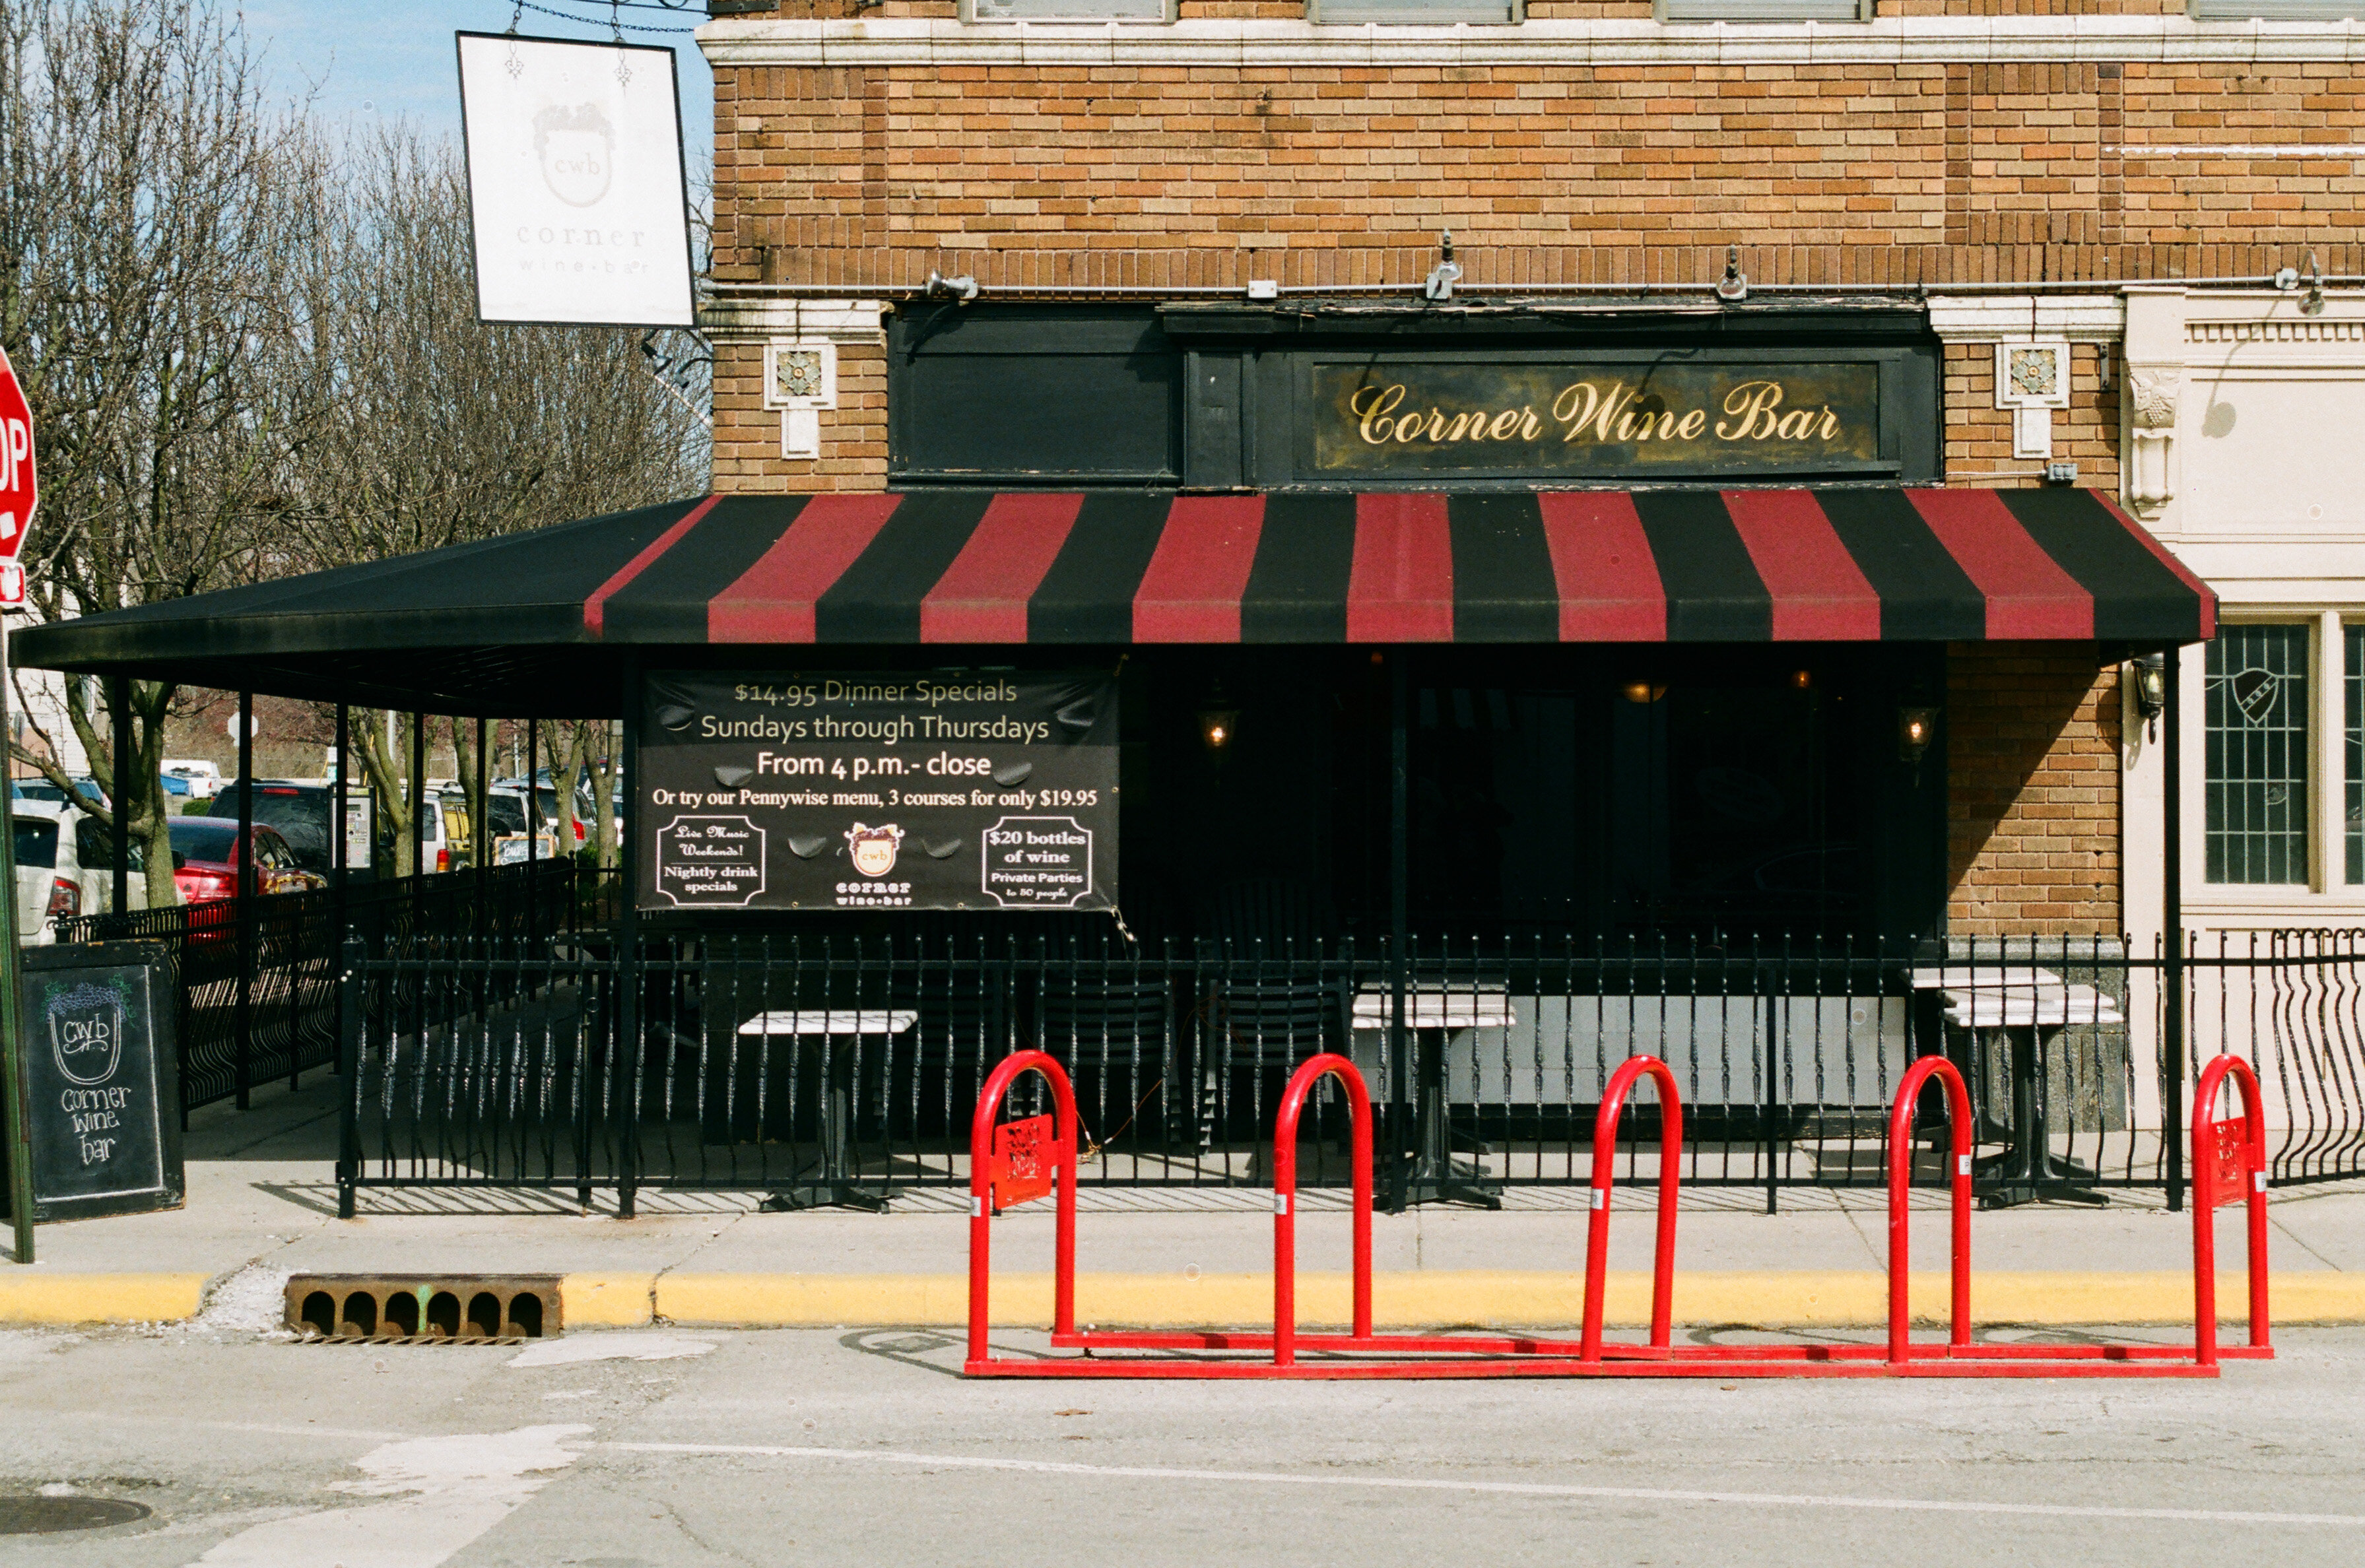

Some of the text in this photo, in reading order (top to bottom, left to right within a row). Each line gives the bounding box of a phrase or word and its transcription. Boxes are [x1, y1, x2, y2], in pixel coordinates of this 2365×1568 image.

[554, 152, 601, 176] cwb
[516, 226, 645, 247] corner
[1350, 382, 1838, 444] Corner Wine Bar
[735, 679, 1018, 708] $14.95 Dinner Specials
[701, 714, 1049, 746] Sundays through Thursdays
[758, 751, 824, 775] From
[830, 758, 848, 781] 4
[926, 750, 991, 775] close
[652, 789, 1098, 810] Or try our Pennywise menu, 3 courses for only $19.95
[675, 826, 749, 839] Live Music
[989, 831, 1086, 845] $20 bottles
[679, 843, 743, 856] Weekends!
[862, 849, 887, 860] cwb
[1004, 849, 1071, 863] of wine
[663, 866, 758, 880] Nightly drink
[990, 872, 1083, 883] Private Parties
[684, 880, 738, 894] specials
[835, 882, 912, 894] corner
[1005, 888, 1017, 897] to
[1035, 887, 1068, 900] people
[79, 1133, 116, 1166] bar
